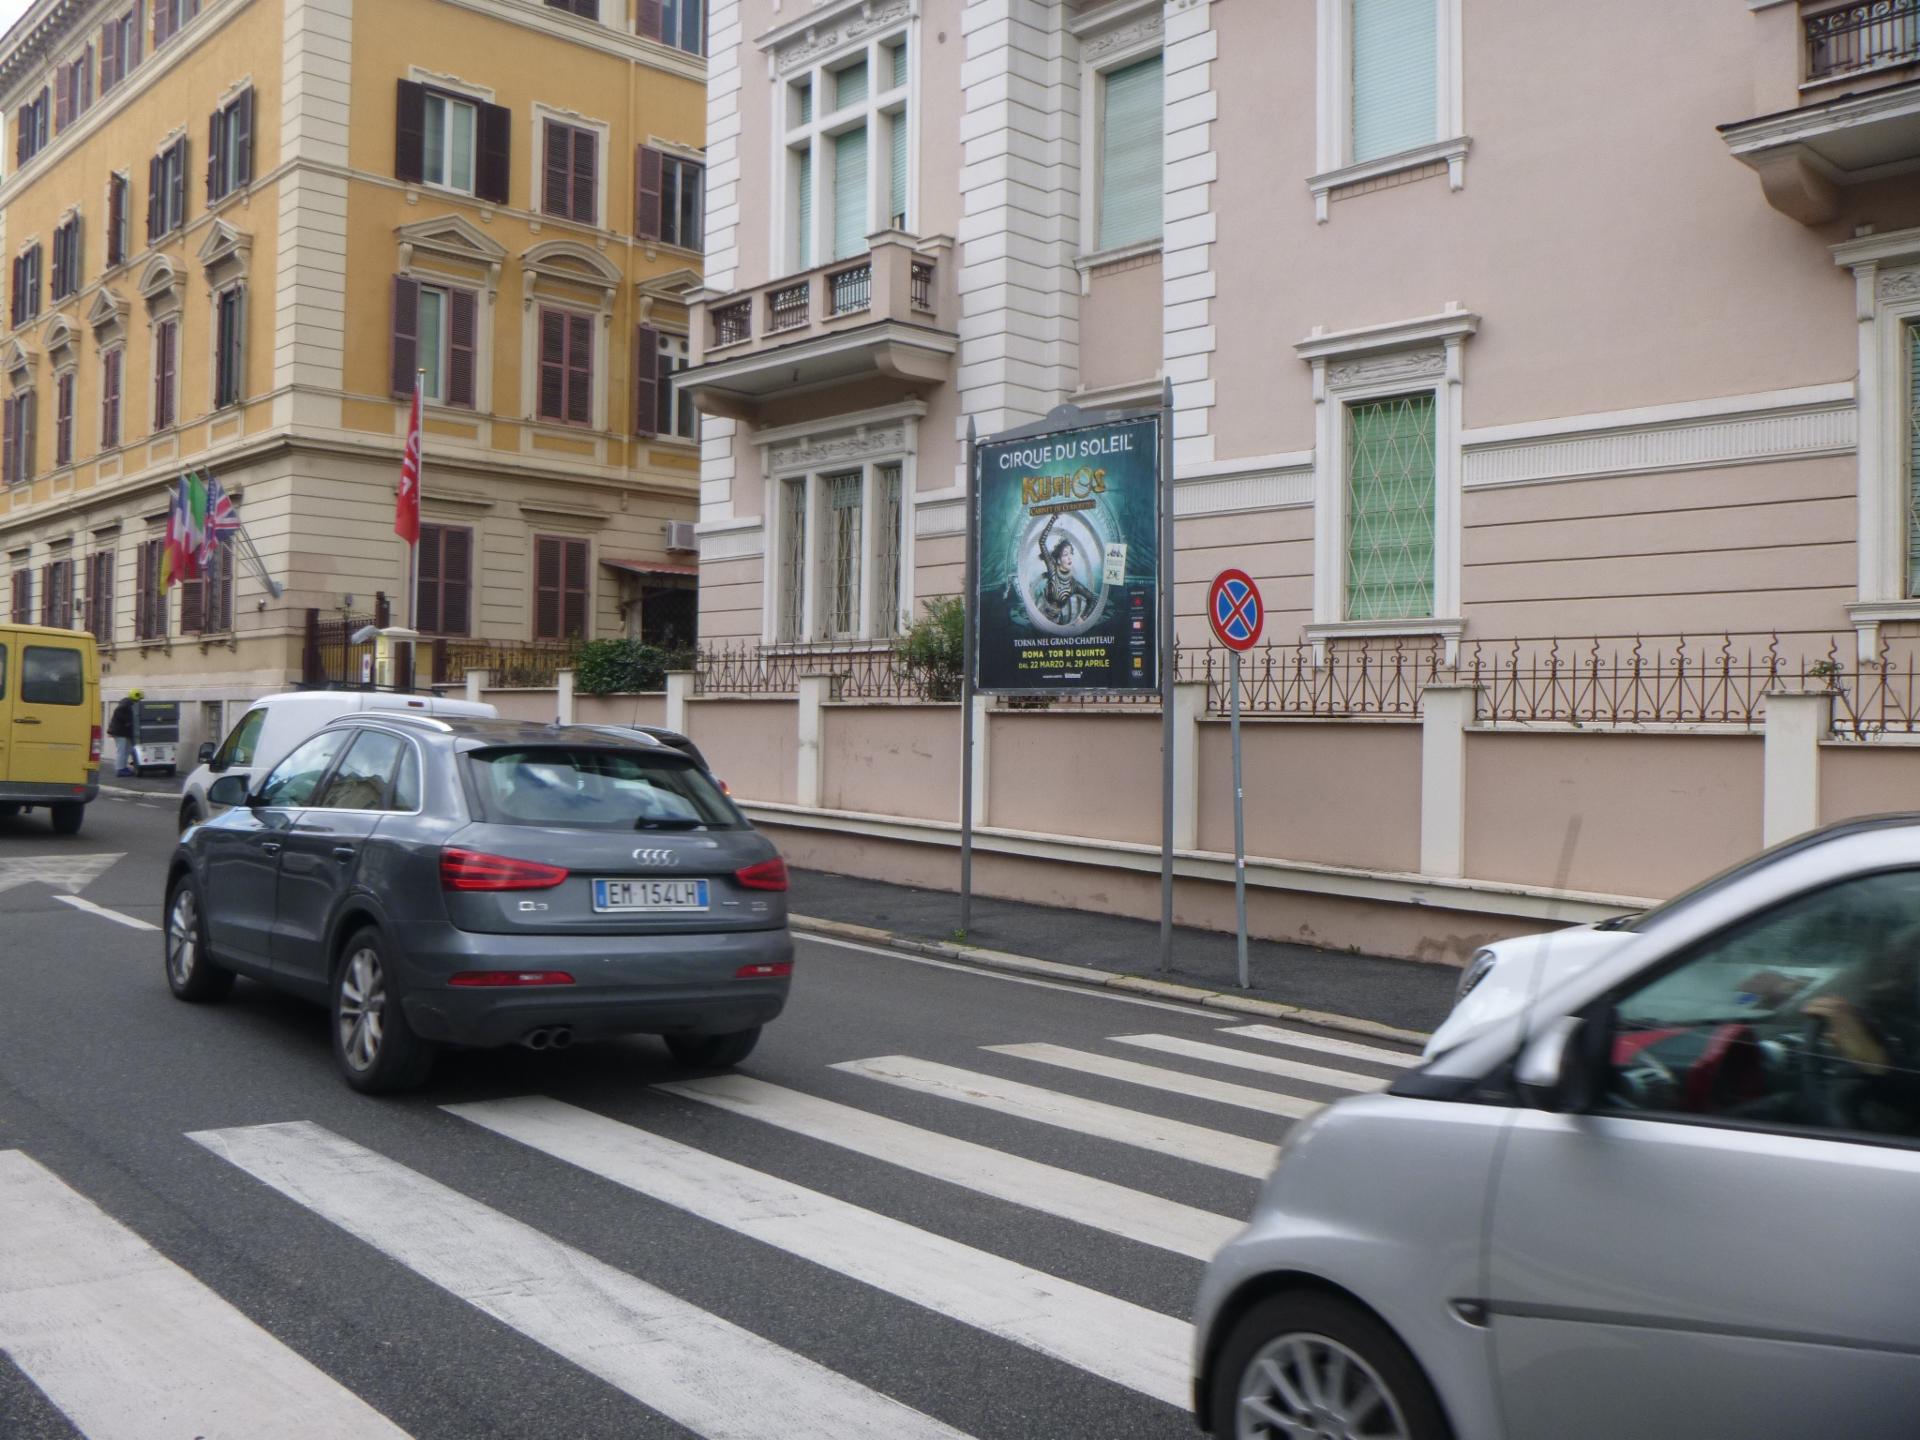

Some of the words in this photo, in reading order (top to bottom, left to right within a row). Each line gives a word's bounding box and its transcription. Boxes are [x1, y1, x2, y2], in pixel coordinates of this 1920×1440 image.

[1000, 446, 1052, 470] CIRQUE
[1055, 442, 1076, 461] DU
[1080, 434, 1133, 457] SOLEIL
[1014, 639, 1036, 647] TORNA
[1037, 638, 1049, 646] NEL
[1050, 637, 1074, 646] GRAND
[1022, 650, 1044, 659] ROMA
[1076, 649, 1106, 657] QUINTO
[1030, 661, 1039, 669] 22
[1040, 660, 1065, 668] MARZO
[1074, 660, 1083, 668] 29
[1084, 659, 1110, 667] APRILE
[609, 883, 632, 904] EM
